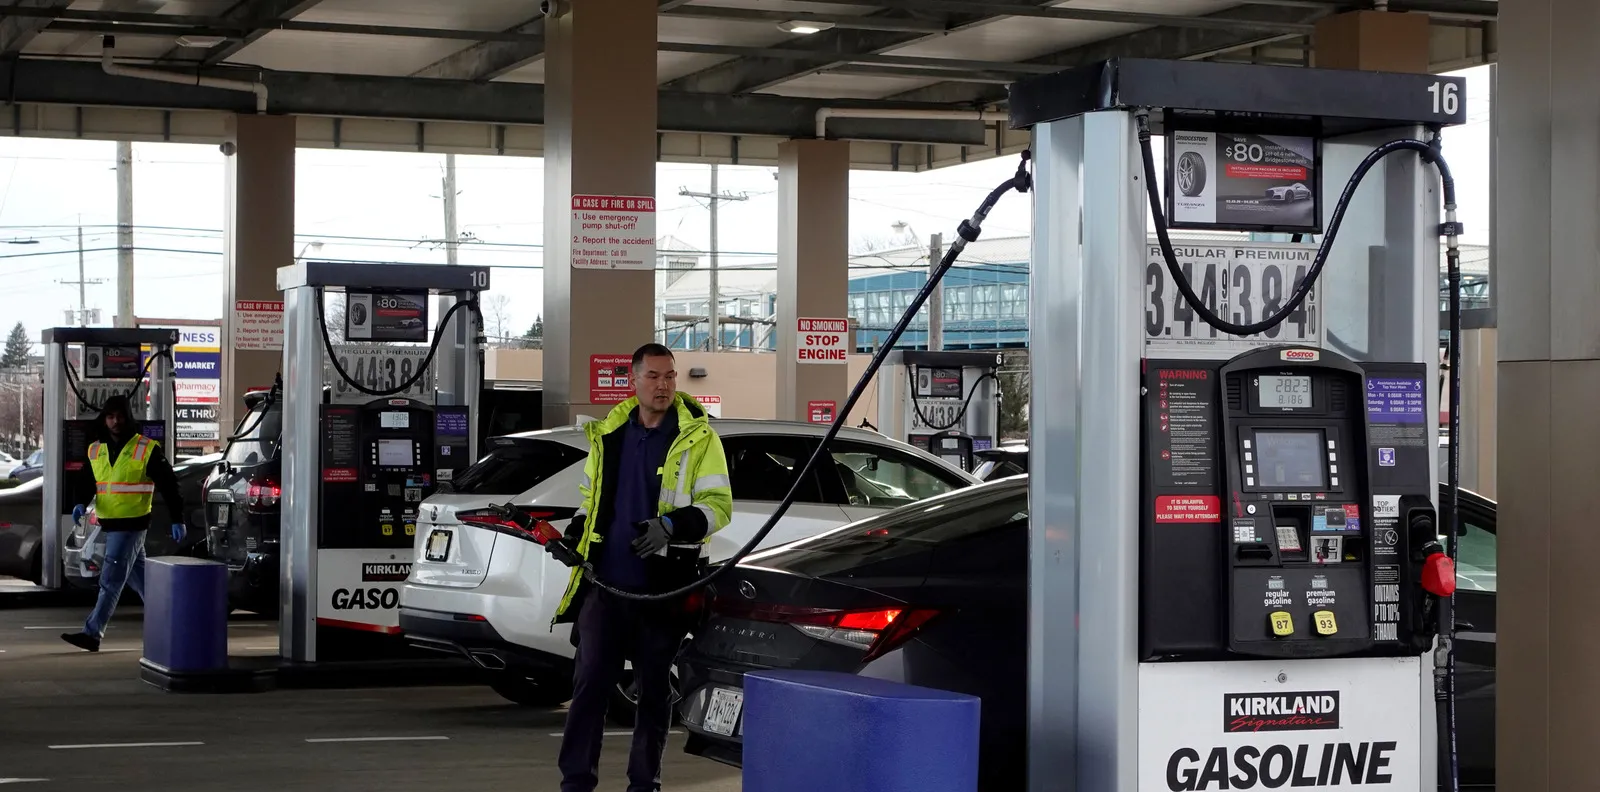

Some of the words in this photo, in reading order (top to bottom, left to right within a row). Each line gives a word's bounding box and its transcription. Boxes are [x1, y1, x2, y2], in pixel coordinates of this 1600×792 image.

[1427, 82, 1459, 115] 16
[1225, 143, 1263, 162] $80
[573, 198, 580, 207] IN
[583, 199, 598, 208] CASE
[601, 199, 609, 208] OF
[611, 199, 624, 208] FIRE
[627, 200, 635, 209] OR
[637, 200, 654, 210] SPILL
[599, 214, 639, 223] emergency
[605, 222, 636, 230] shut-off!
[582, 236, 606, 244] Report
[608, 236, 620, 244] the
[622, 237, 654, 245] accident!
[1151, 248, 1226, 258] RGULAR
[1235, 250, 1309, 260] PREMIUM
[470, 271, 487, 287] 10
[800, 320, 810, 331] NO
[812, 320, 845, 331] SMOKING
[170, 331, 176, 341] 4
[806, 335, 839, 346] STOP
[799, 348, 846, 360] ENGINE
[1286, 349, 1315, 358] COSTCO
[996, 354, 1002, 364] 6
[184, 361, 216, 370] MARKET
[385, 357, 425, 394] 384
[1159, 370, 1207, 380] WARNING
[176, 382, 216, 392] pharmacy
[1253, 379, 1259, 387] $
[190, 409, 216, 419] THRU
[1265, 589, 1290, 598] regular
[1306, 589, 1335, 598] premium
[331, 588, 402, 610] GASO
[1264, 597, 1292, 606] gasoline
[1307, 597, 1335, 606] gasoline
[1379, 604, 1387, 621] TO
[1387, 604, 1400, 621] 10%
[1276, 620, 1288, 629] 87
[1320, 620, 1333, 628] 93
[1230, 696, 1335, 716] KIRKLAND
[1230, 715, 1337, 733] Signature
[1166, 741, 1397, 792] GASOLINE
